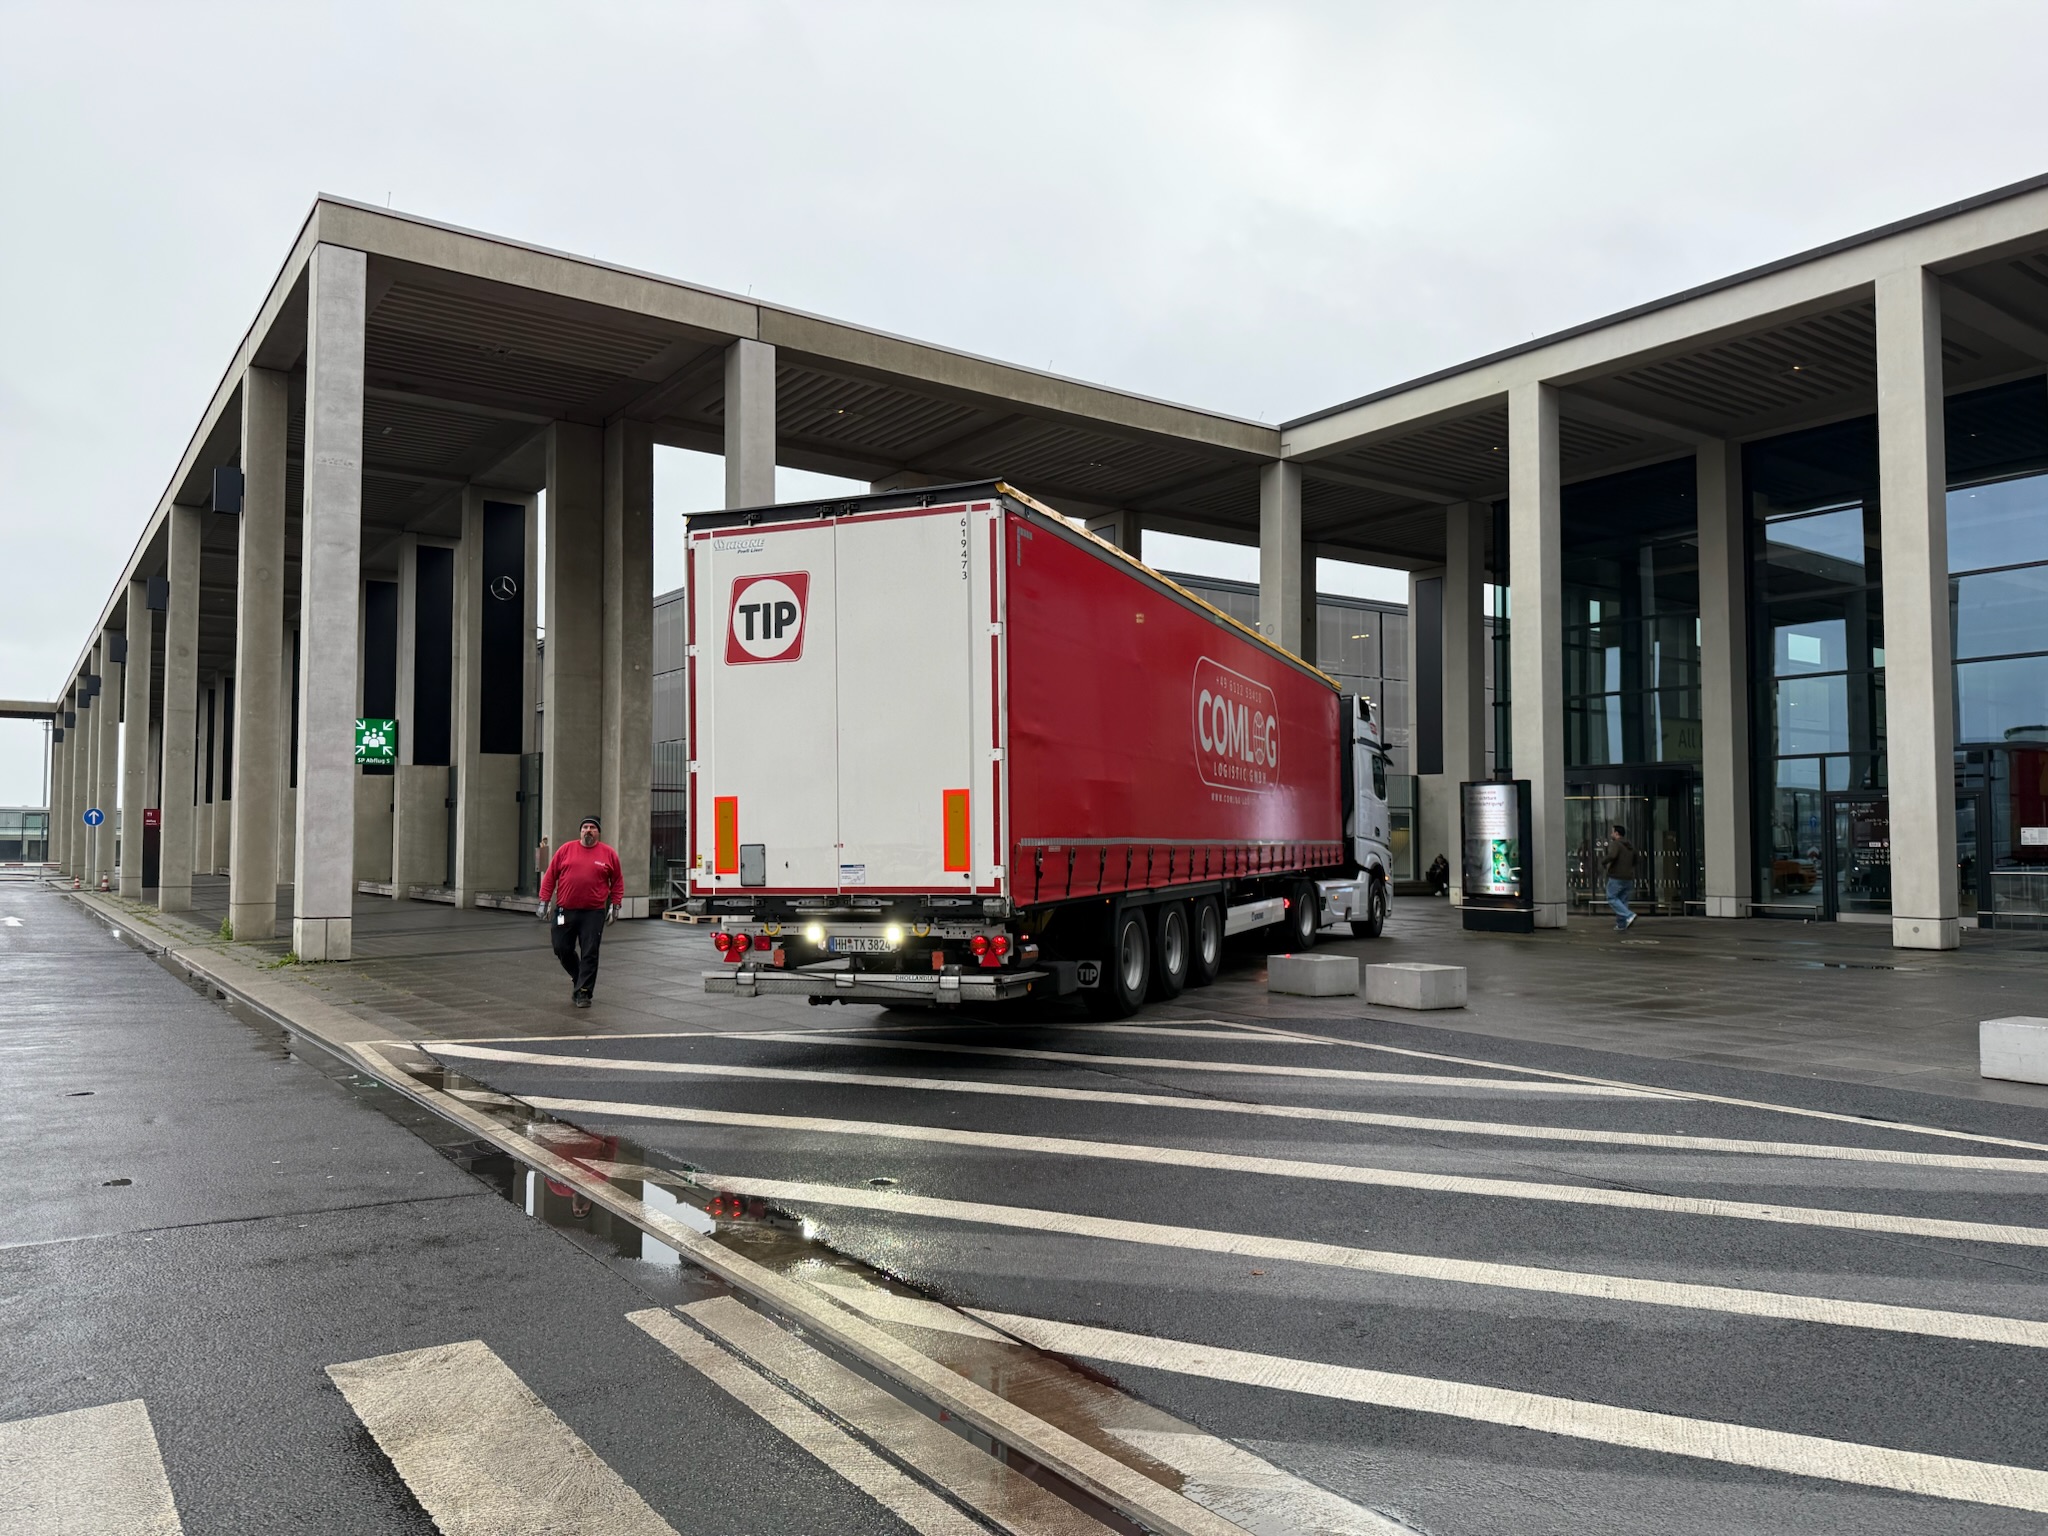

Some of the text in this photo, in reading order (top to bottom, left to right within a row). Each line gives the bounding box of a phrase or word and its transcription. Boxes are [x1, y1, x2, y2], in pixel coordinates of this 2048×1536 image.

[960, 517, 968, 580] 619473
[739, 601, 797, 641] TIP
[1198, 689, 1276, 768] COMLOG
[365, 757, 385, 765] Abflug
[1213, 762, 1247, 781] LOGISTIC
[835, 938, 891, 951] HH TX 3824
[895, 974, 934, 982] DHOLLANDIA
[1078, 968, 1098, 981] TIP
